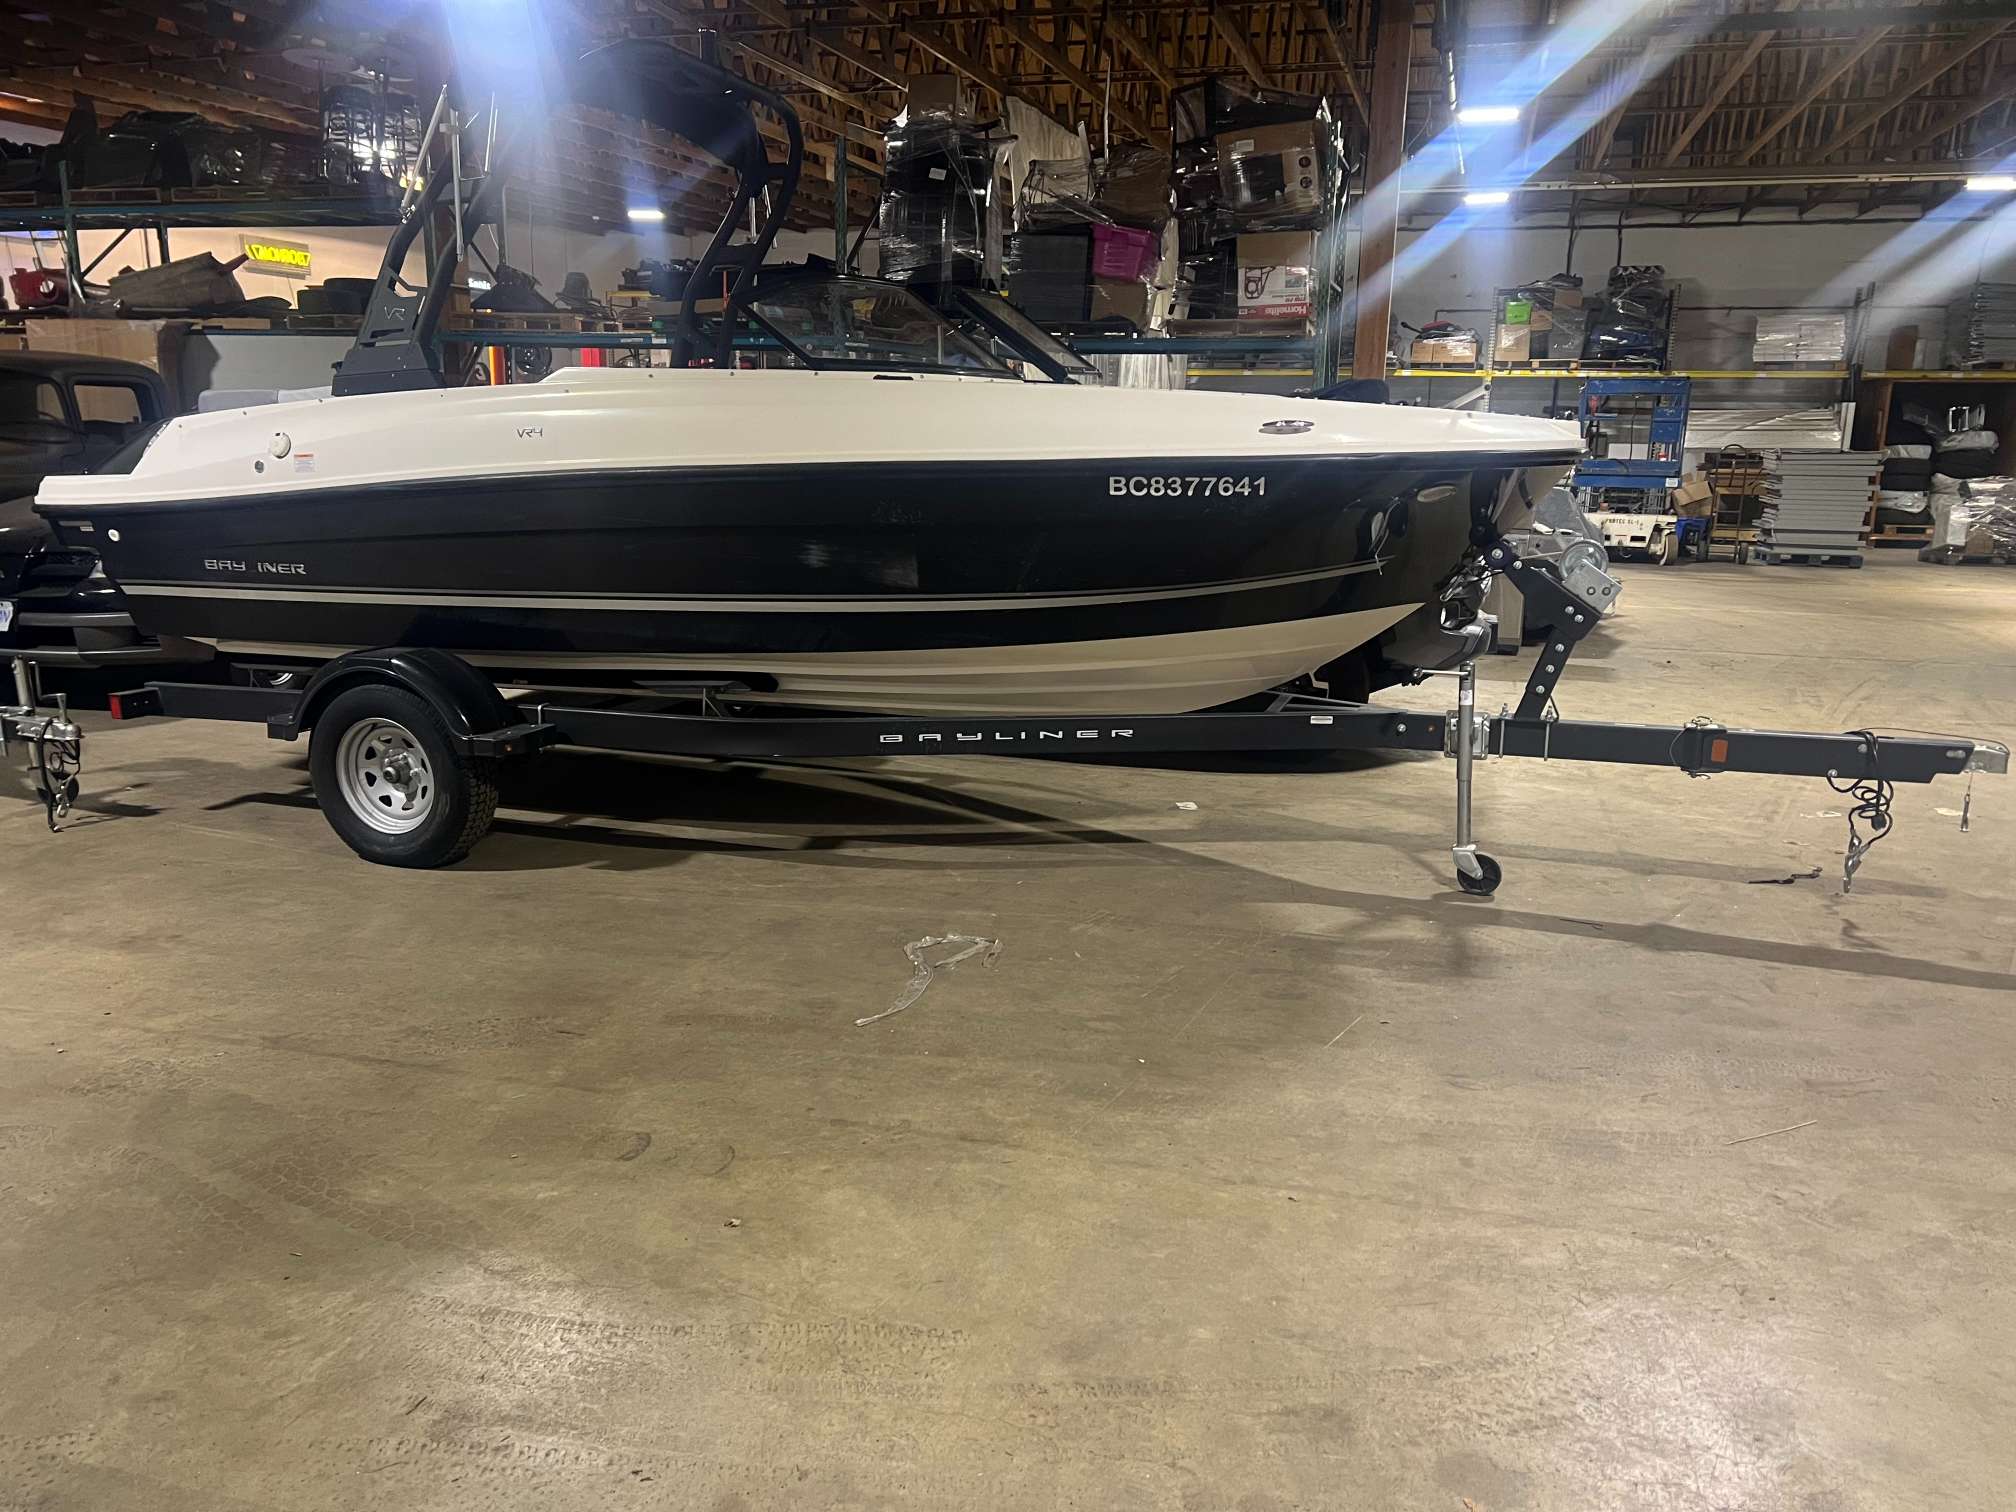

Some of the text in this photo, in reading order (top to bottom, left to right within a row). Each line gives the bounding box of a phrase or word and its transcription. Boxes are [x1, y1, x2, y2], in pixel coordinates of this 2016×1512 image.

[384, 306, 405, 320] VR
[516, 427, 543, 439] VR4
[1109, 476, 1266, 497] BC8377641
[879, 728, 1134, 743] BAYLINER
